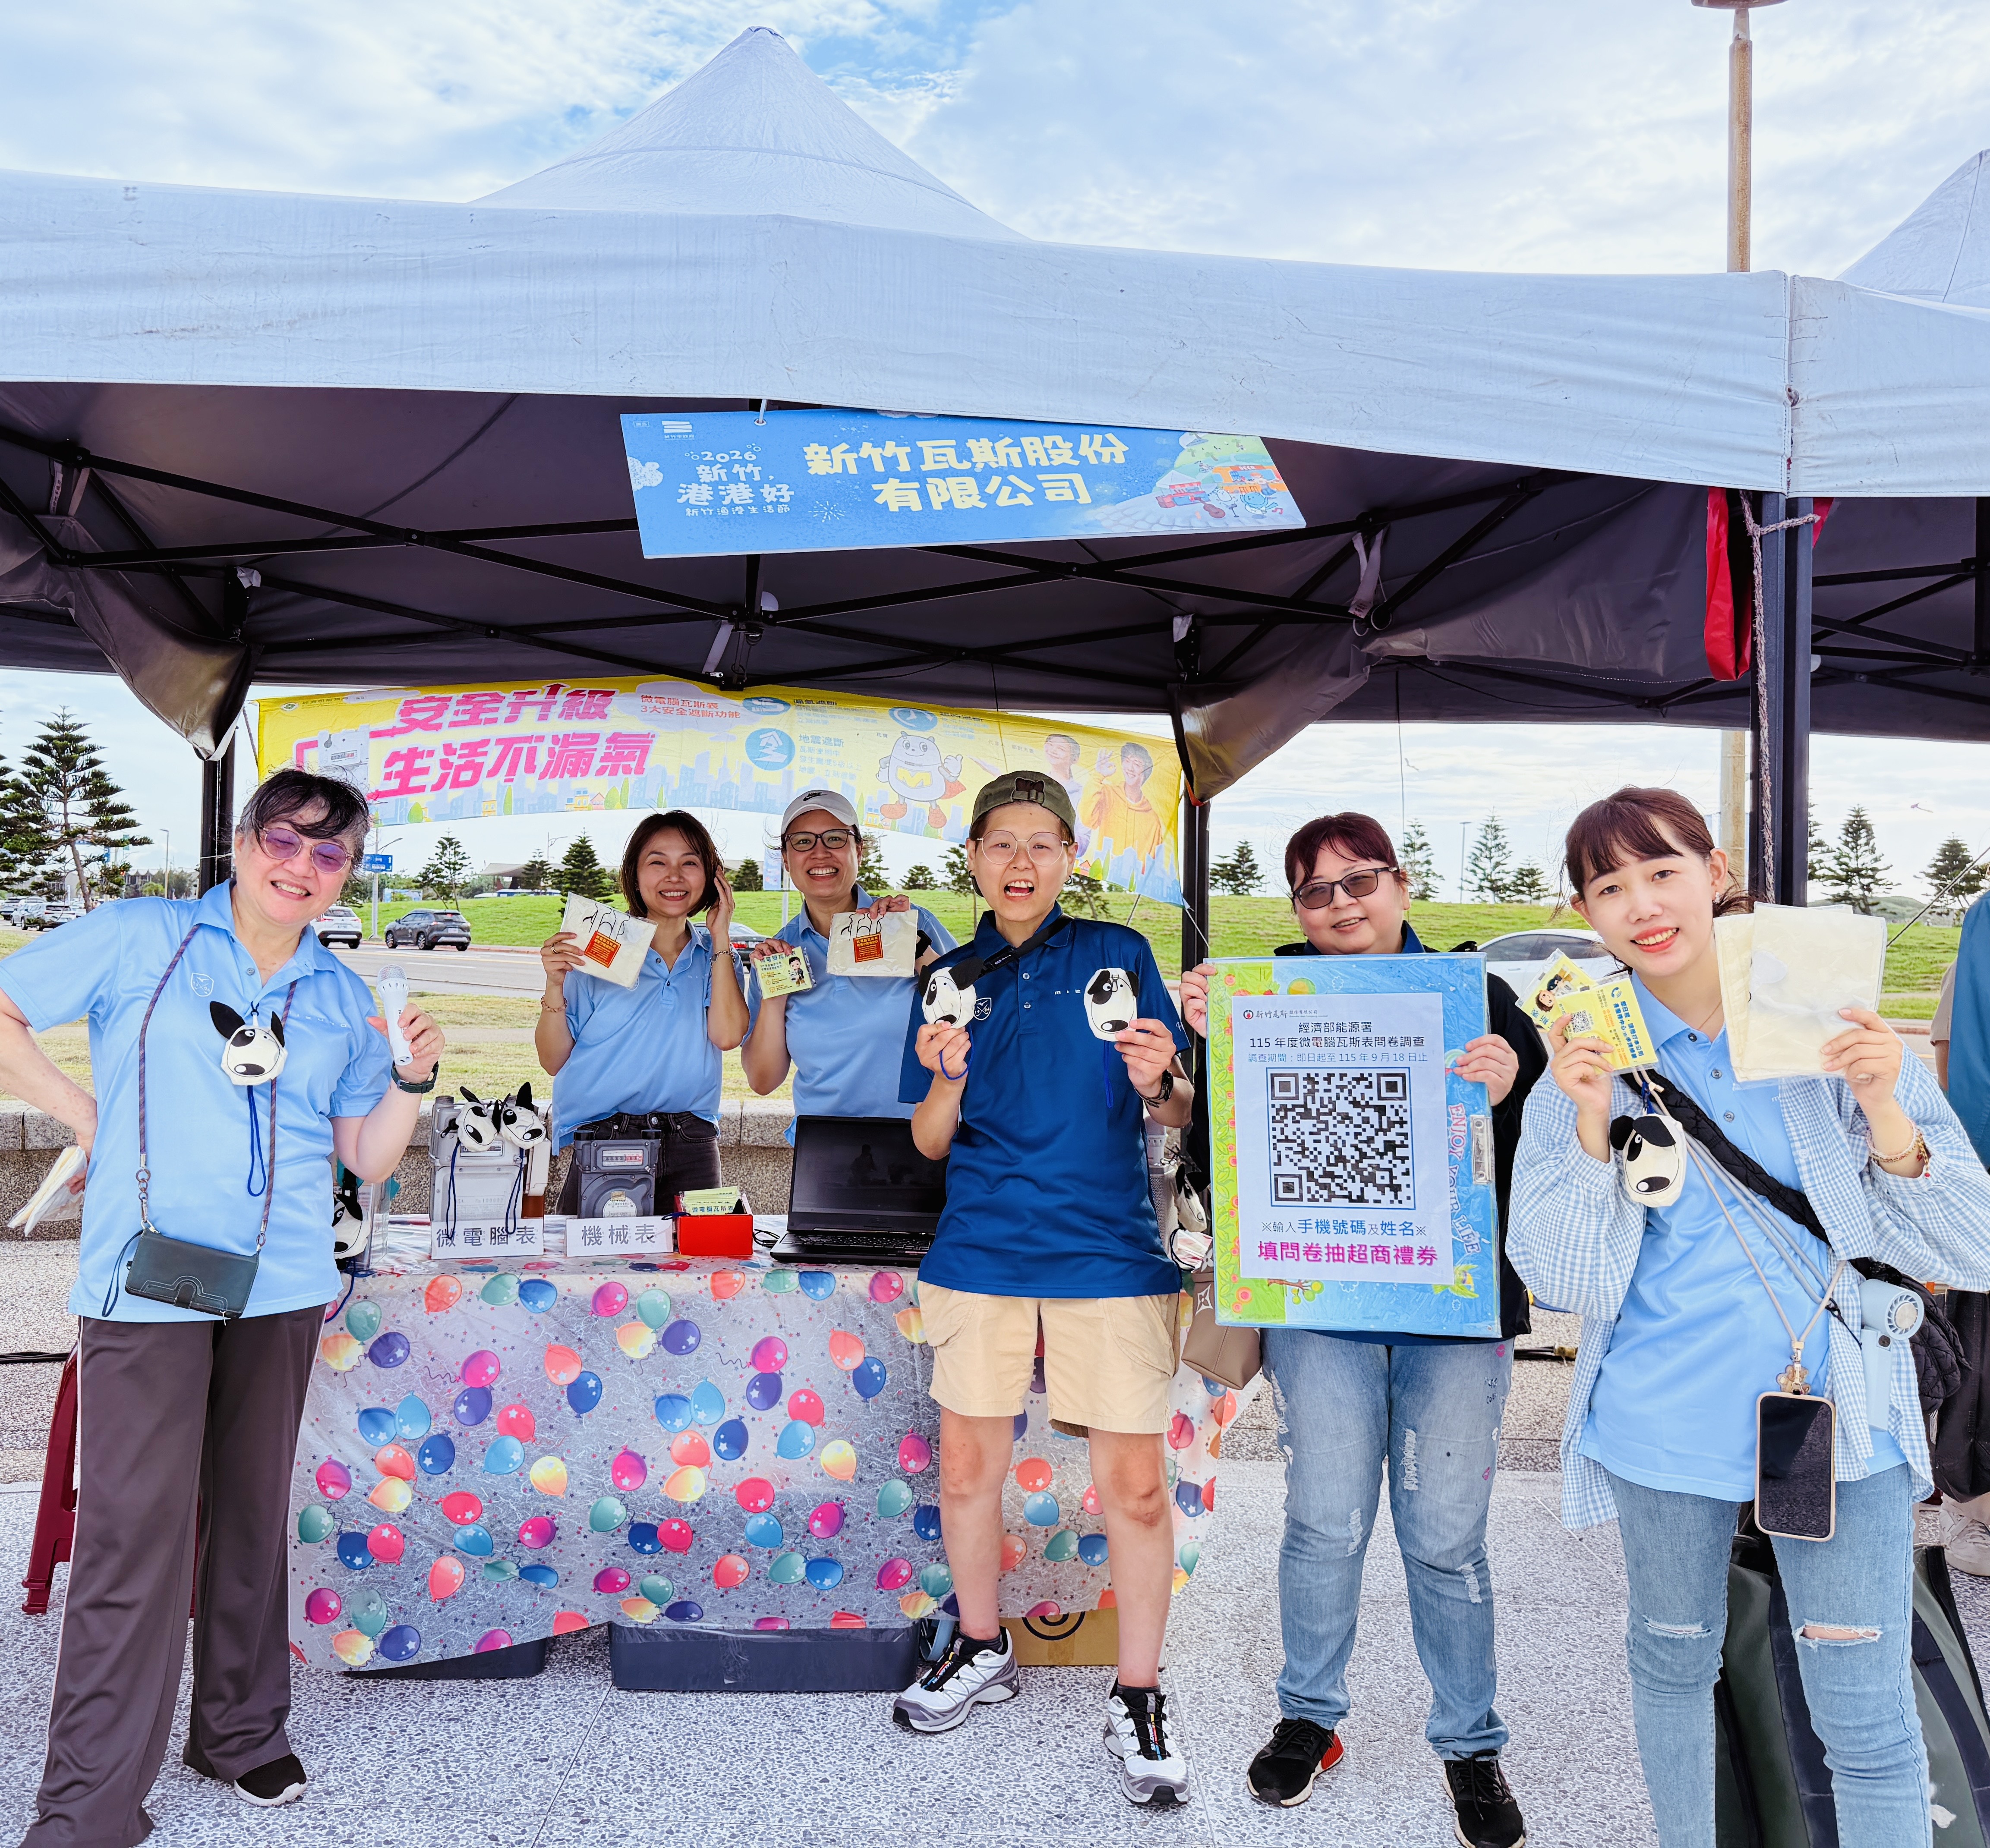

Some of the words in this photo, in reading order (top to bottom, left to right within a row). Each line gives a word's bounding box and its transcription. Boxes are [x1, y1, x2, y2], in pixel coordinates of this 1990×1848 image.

[701, 450, 757, 463] 2026
[803, 433, 1129, 475] 新竹瓦斯股份
[677, 482, 795, 506] 港港好
[871, 473, 1093, 512] 有限公司
[685, 504, 791, 516] 新竹漁港生活節
[395, 686, 619, 735] 安全升級
[641, 695, 719, 709] 微電腦瓦斯表
[641, 705, 741, 718] 3大安全遮斷功能
[798, 734, 845, 748] 地震遮斷
[373, 731, 657, 800] 生活不漏氣
[1255, 1010, 1288, 1019] 新竹瓦斯
[1299, 1022, 1372, 1033] 經濟部能源署
[1250, 1038, 1271, 1048] 115
[1274, 1036, 1425, 1048] 年度微電腦瓦斯表問卷調查
[1339, 1053, 1356, 1062] 115
[1359, 1053, 1369, 1062] 年
[1371, 1053, 1378, 1062] 9
[1381, 1053, 1390, 1062] 月
[1393, 1053, 1405, 1062] 18
[1408, 1052, 1428, 1062] 日止
[1448, 1103, 1466, 1161] ENJOY
[436, 1226, 536, 1248] 微電腦表
[582, 1224, 656, 1246] 機械表
[1452, 1215, 1481, 1253] LIFE
[1258, 1240, 1438, 1266] 填問卷抽超商禮券
